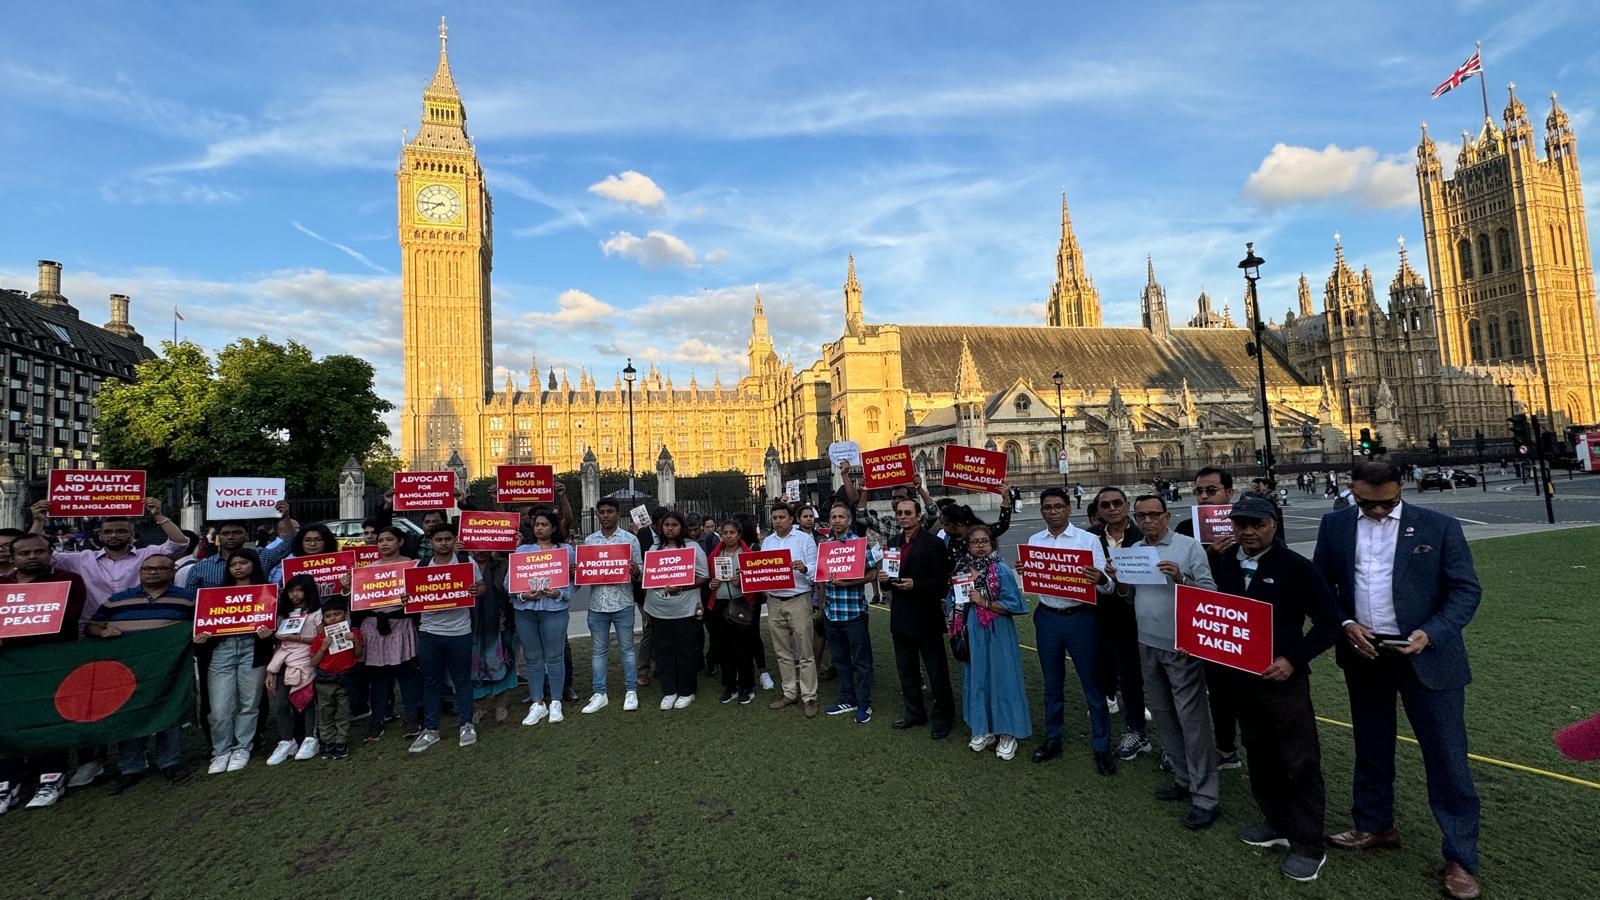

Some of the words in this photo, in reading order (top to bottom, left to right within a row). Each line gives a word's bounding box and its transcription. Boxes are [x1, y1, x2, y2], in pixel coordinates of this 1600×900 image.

[881, 453, 906, 461] VOICES
[964, 456, 986, 464] SAVE
[953, 463, 984, 474] HINDUS
[871, 470, 906, 480] WEAPONS
[945, 471, 1002, 484] BANGLADESH
[216, 500, 275, 508] UNHEARD
[829, 546, 856, 555] ACTION
[526, 554, 552, 562] STAND
[659, 556, 682, 565] STOP
[826, 556, 846, 564] MUST
[1029, 550, 1080, 563] EQUALITY
[303, 558, 336, 568] STAND
[746, 558, 784, 567] EMPOWER
[1024, 561, 1045, 570] AND
[1048, 563, 1086, 574] JUSTIC
[375, 571, 397, 580] SAVE
[428, 573, 451, 582] SAVE
[529, 569, 562, 577] MINORITIES
[363, 580, 397, 590] HINDUS
[416, 582, 451, 592] HINDUS
[1040, 582, 1086, 593] BANGLADESH
[6, 593, 26, 603] BE
[225, 594, 253, 604] SAVE
[354, 588, 405, 602] BANGLADE
[0, 602, 60, 614] OTESTER
[209, 605, 252, 615] HINDUS
[1196, 602, 1248, 623] ACTION
[3, 614, 51, 626] PEACE
[198, 613, 272, 626] BANGLADESH
[1192, 616, 1229, 635] MUST
[1232, 626, 1250, 640] BE
[1197, 633, 1242, 655] TAKEN
